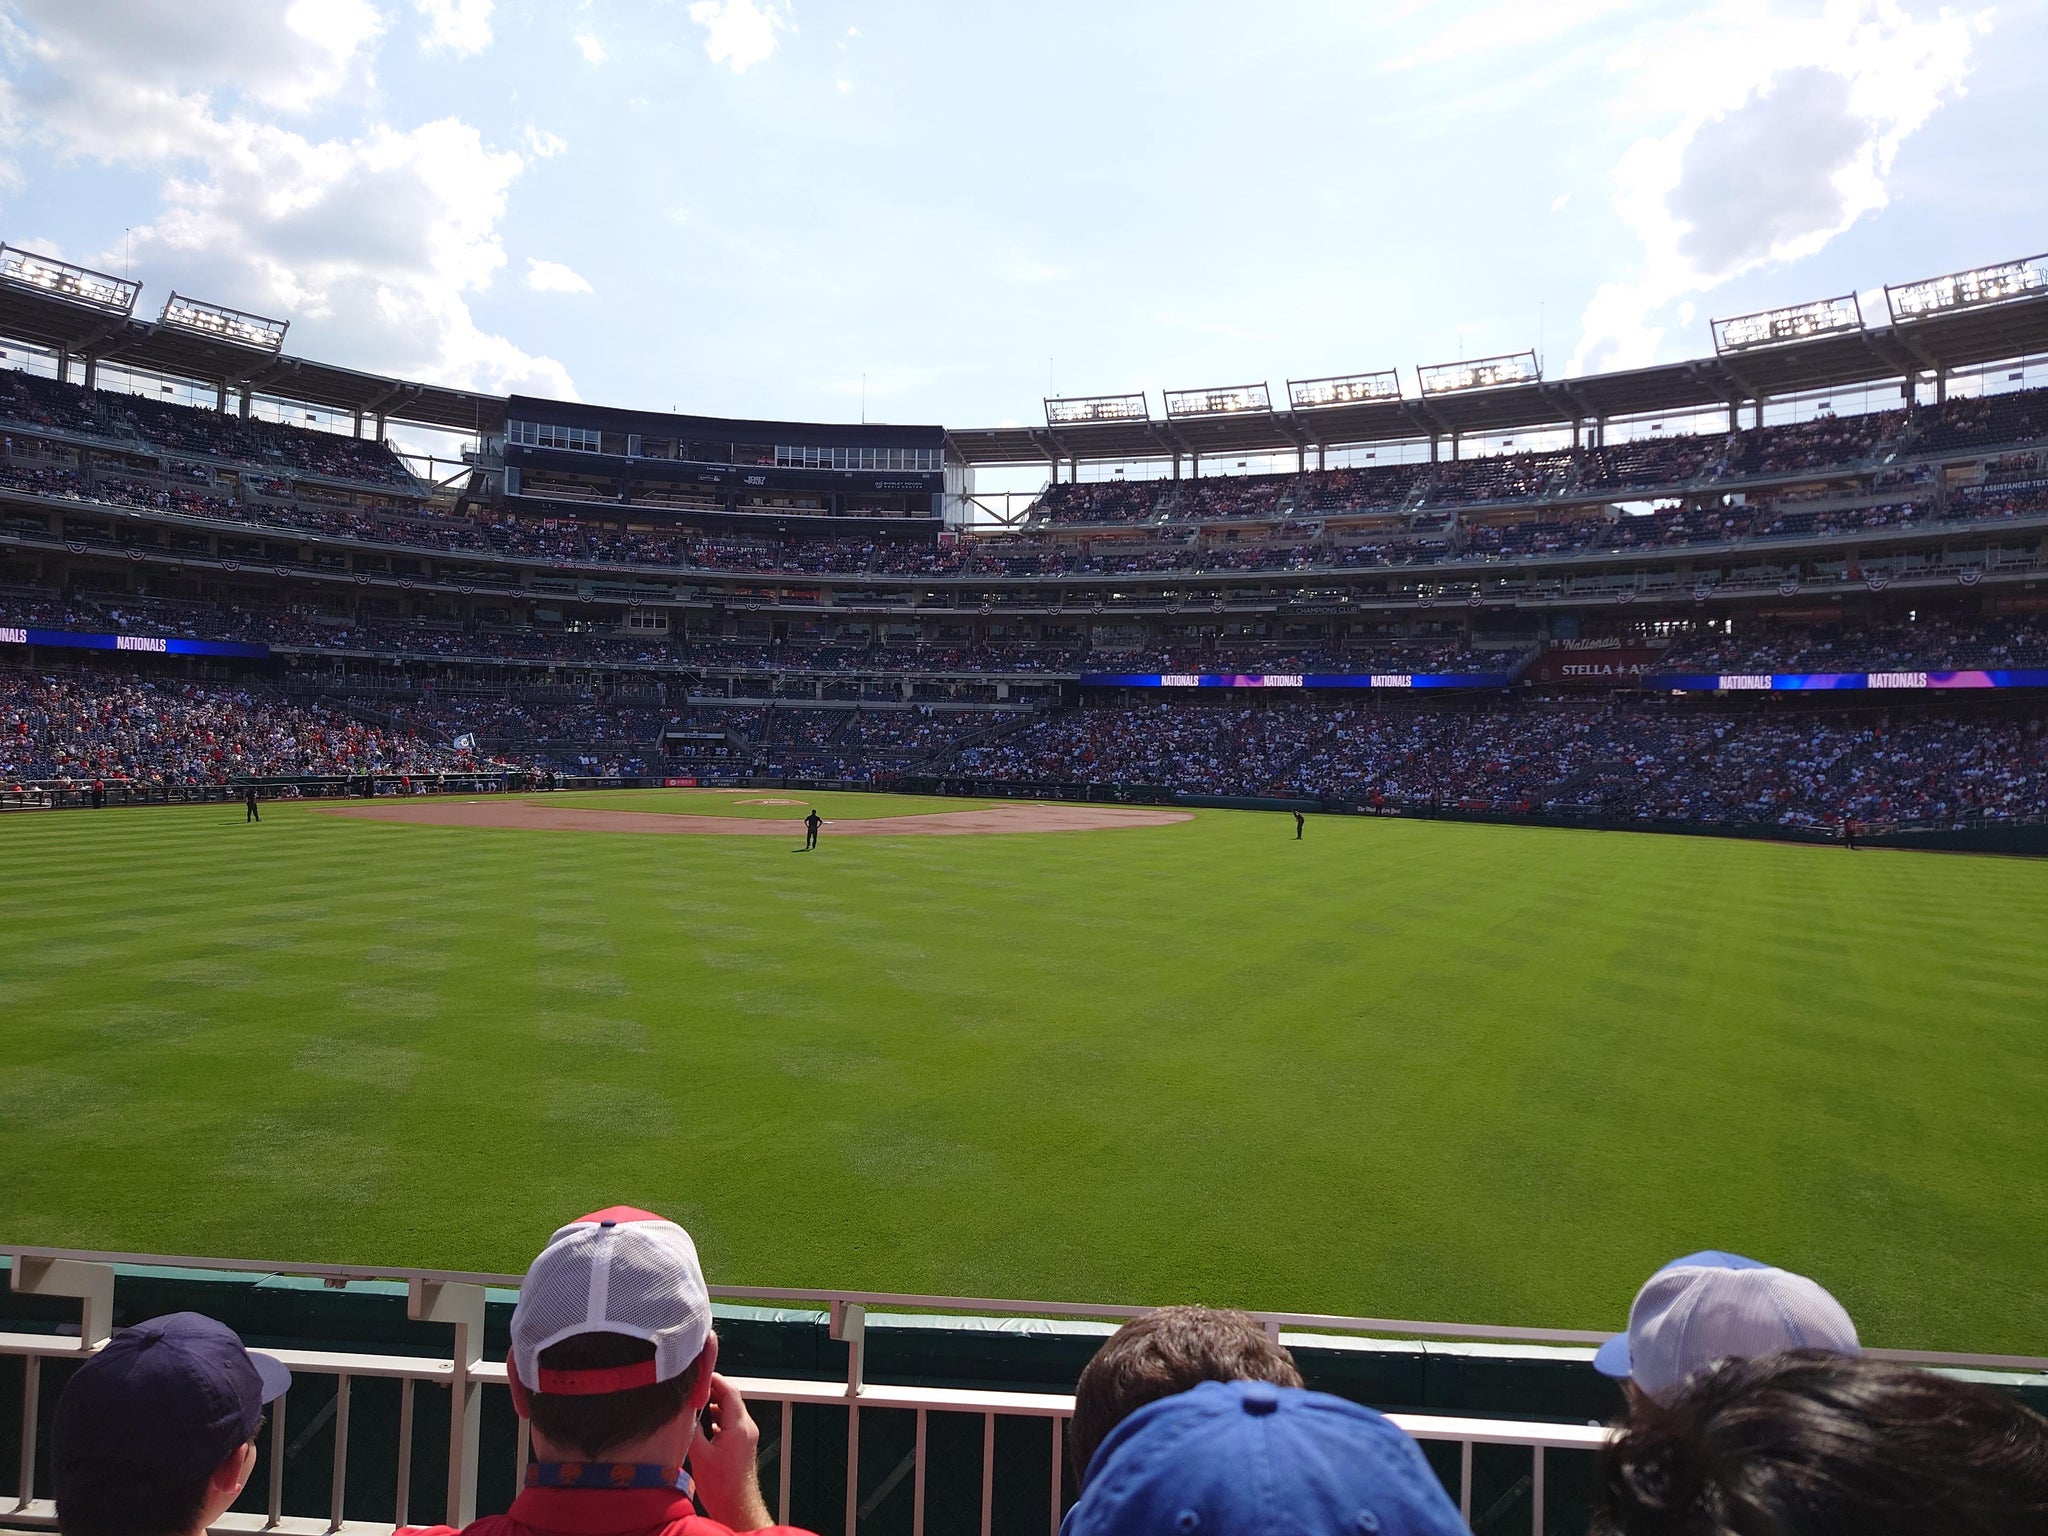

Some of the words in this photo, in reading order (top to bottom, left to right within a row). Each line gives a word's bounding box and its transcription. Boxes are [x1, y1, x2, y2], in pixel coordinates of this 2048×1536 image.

[1963, 486, 1982, 494] NEED
[1984, 481, 2031, 492] ASSISTANCE?
[575, 563, 608, 571] WASHINGTON
[609, 565, 635, 573] NATIONALS
[1296, 606, 1337, 615] CHAMPIONS
[1338, 606, 1357, 614] CLUB
[0, 628, 27, 643] NALS
[117, 635, 166, 652] NATIONALS
[1562, 637, 1621, 651] Nationals
[1561, 664, 1612, 676] STELLA
[1161, 675, 1199, 687] NATIONALS
[1263, 675, 1303, 687] NATIONALS
[1370, 675, 1412, 687] NATIONALS
[1718, 675, 1772, 690] NATIONALS
[1867, 672, 1927, 689] NATIONALS
